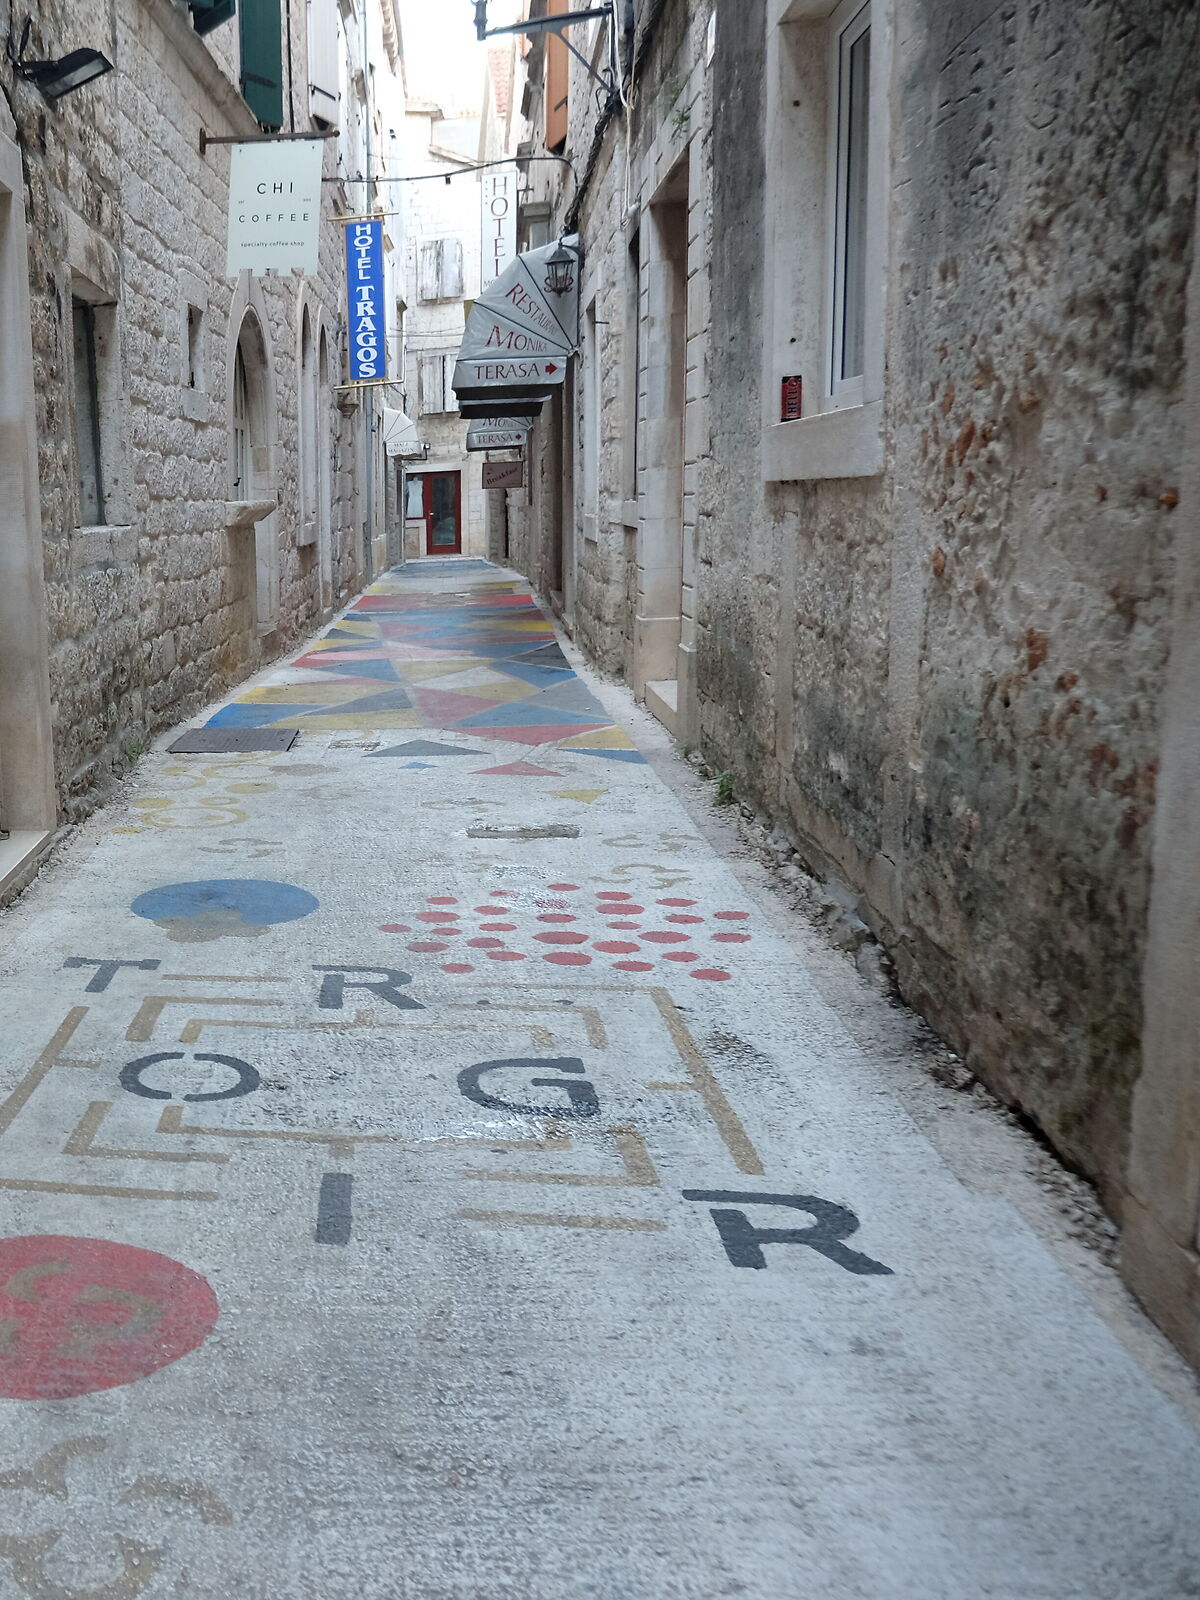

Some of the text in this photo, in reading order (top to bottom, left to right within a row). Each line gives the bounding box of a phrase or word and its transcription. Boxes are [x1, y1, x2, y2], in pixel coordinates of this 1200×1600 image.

[256, 181, 294, 195] CHI
[238, 212, 311, 224] COFFEE
[290, 239, 305, 247] shop
[353, 223, 378, 378] HOTEL TRAGOS
[474, 362, 541, 380] TERASA
[478, 433, 513, 444] TERASA
